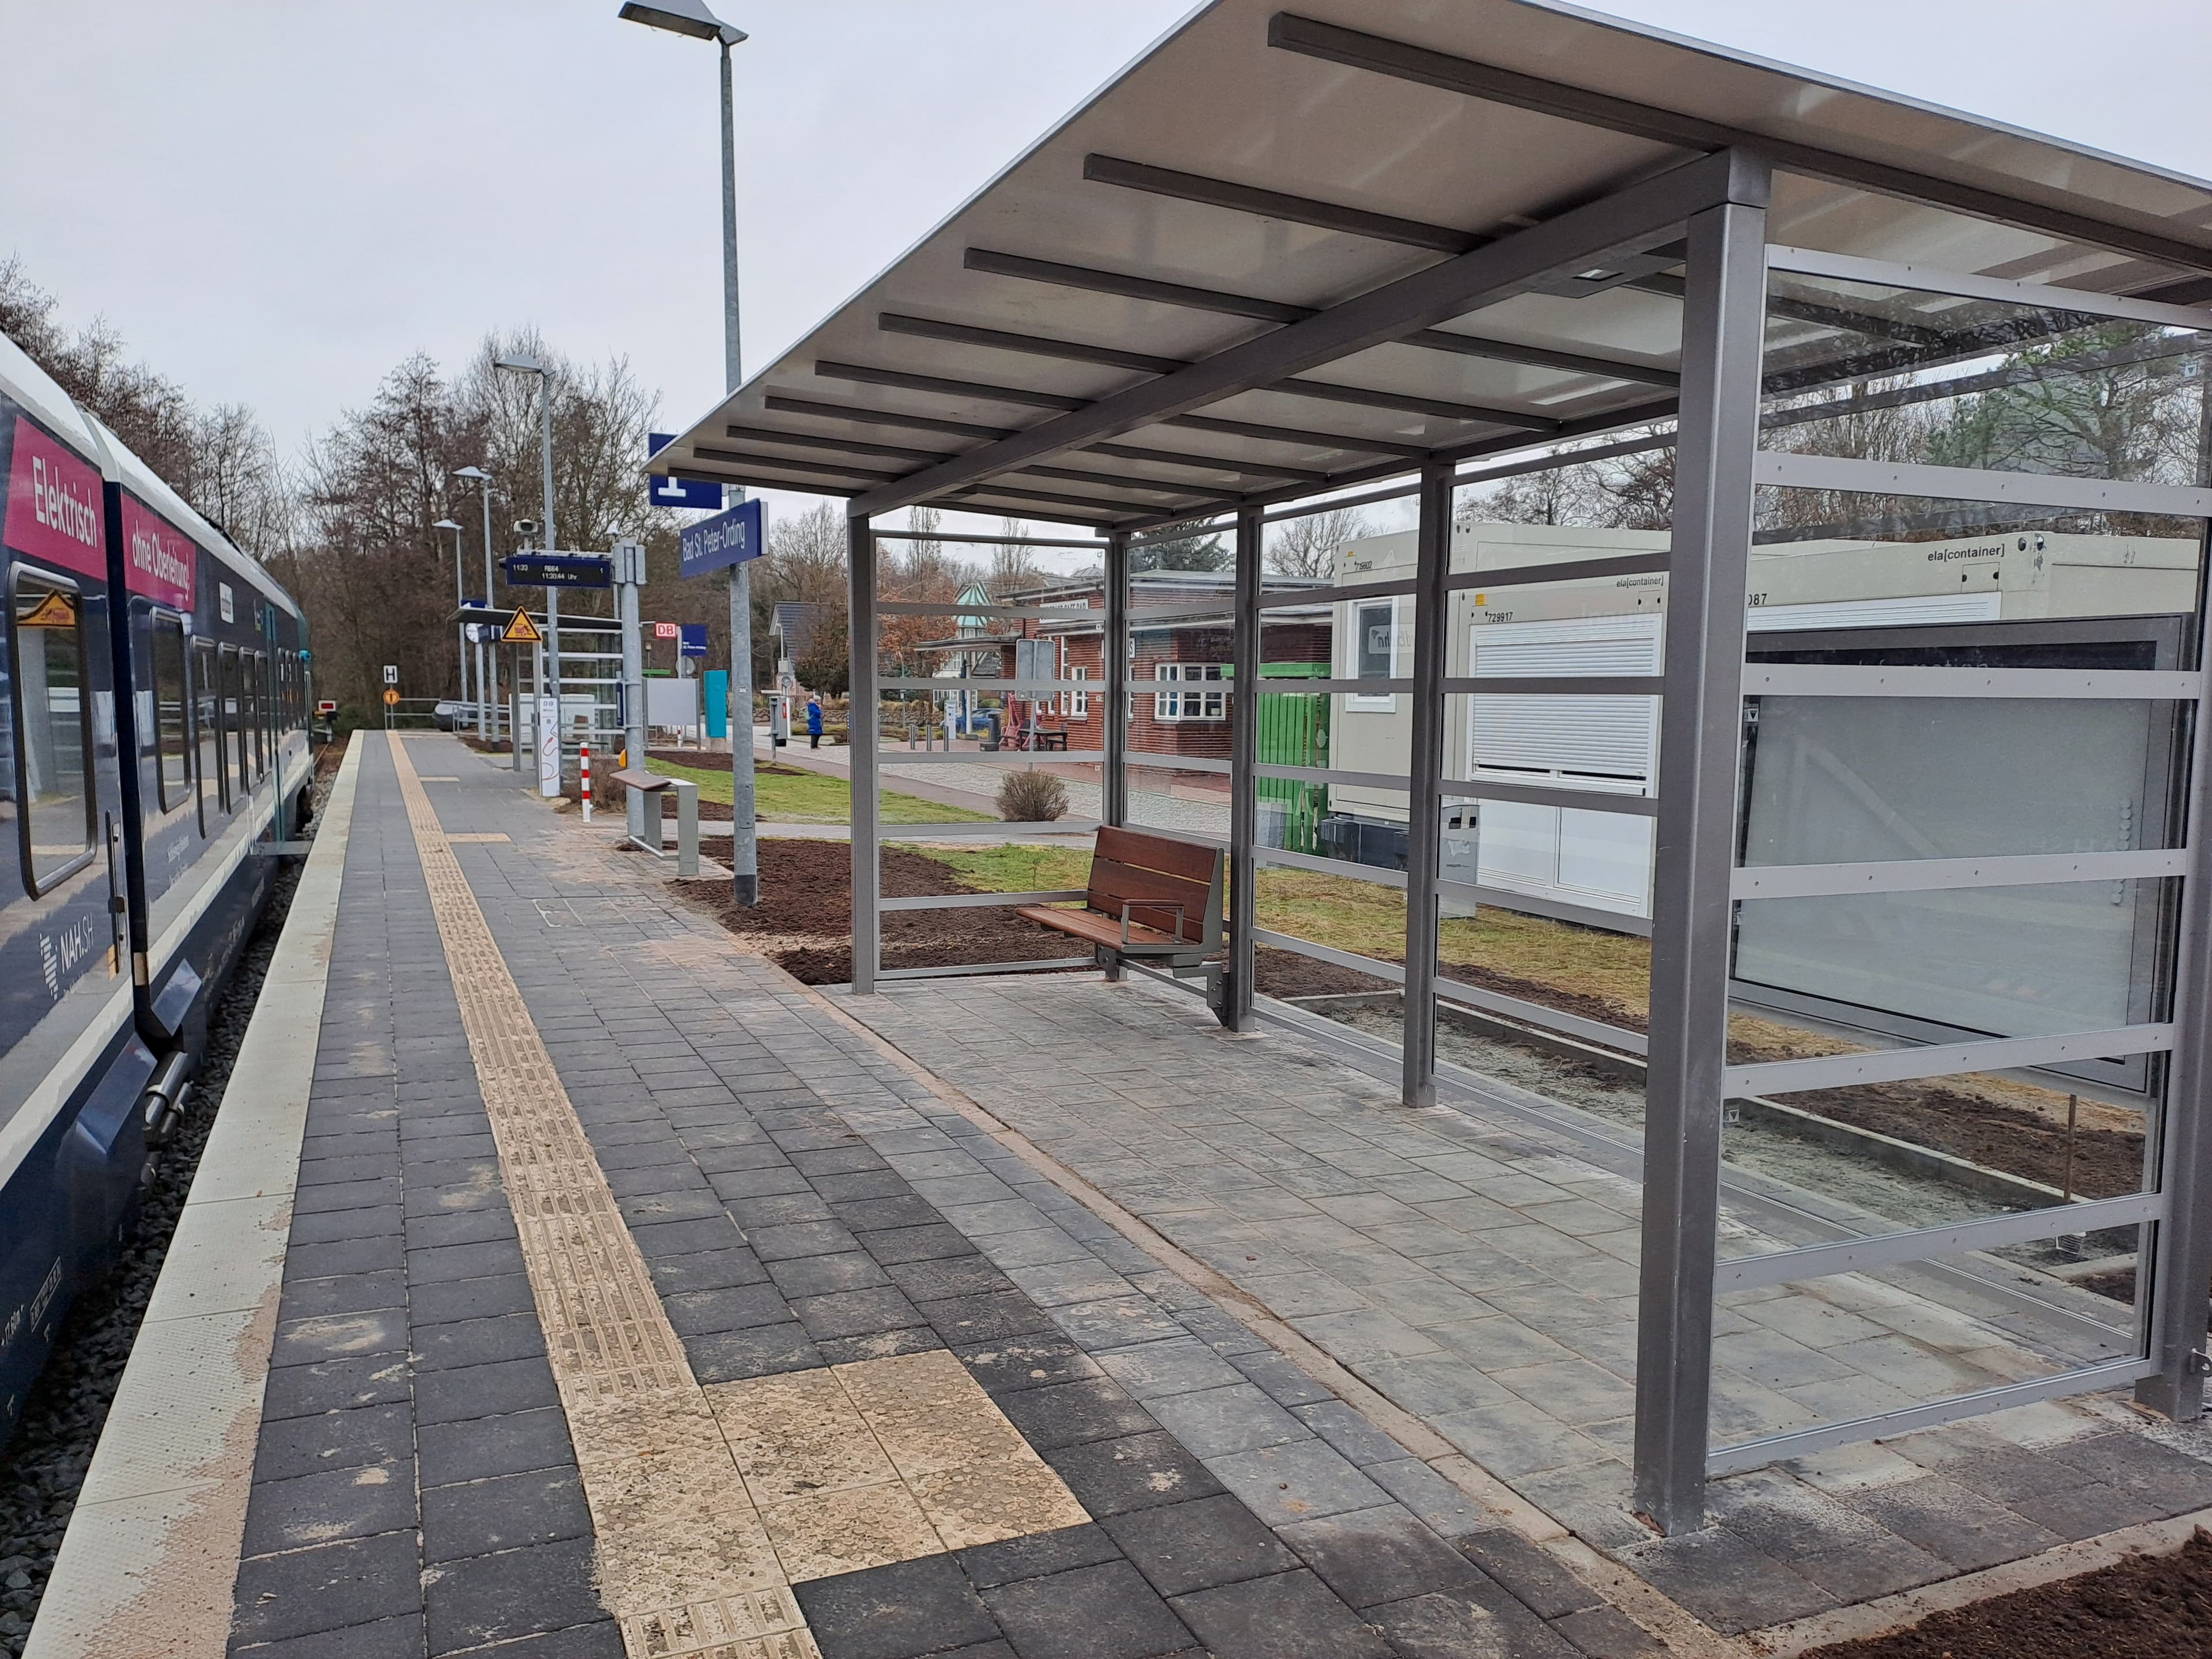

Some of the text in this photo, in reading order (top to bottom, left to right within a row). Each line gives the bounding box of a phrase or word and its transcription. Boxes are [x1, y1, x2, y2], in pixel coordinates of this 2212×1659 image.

[32, 454, 97, 548] Elektrisch
[682, 536, 694, 562] Bad
[703, 518, 745, 555] Peter-Ording
[132, 520, 190, 601] ohne Oberleitung!
[1927, 544, 2006, 562] ela[container]
[1616, 575, 1664, 589] ela[container]
[1488, 612, 1513, 623] 729917
[658, 625, 673, 635] DB
[386, 668, 395, 681] H
[60, 912, 93, 974] NAH.SH
